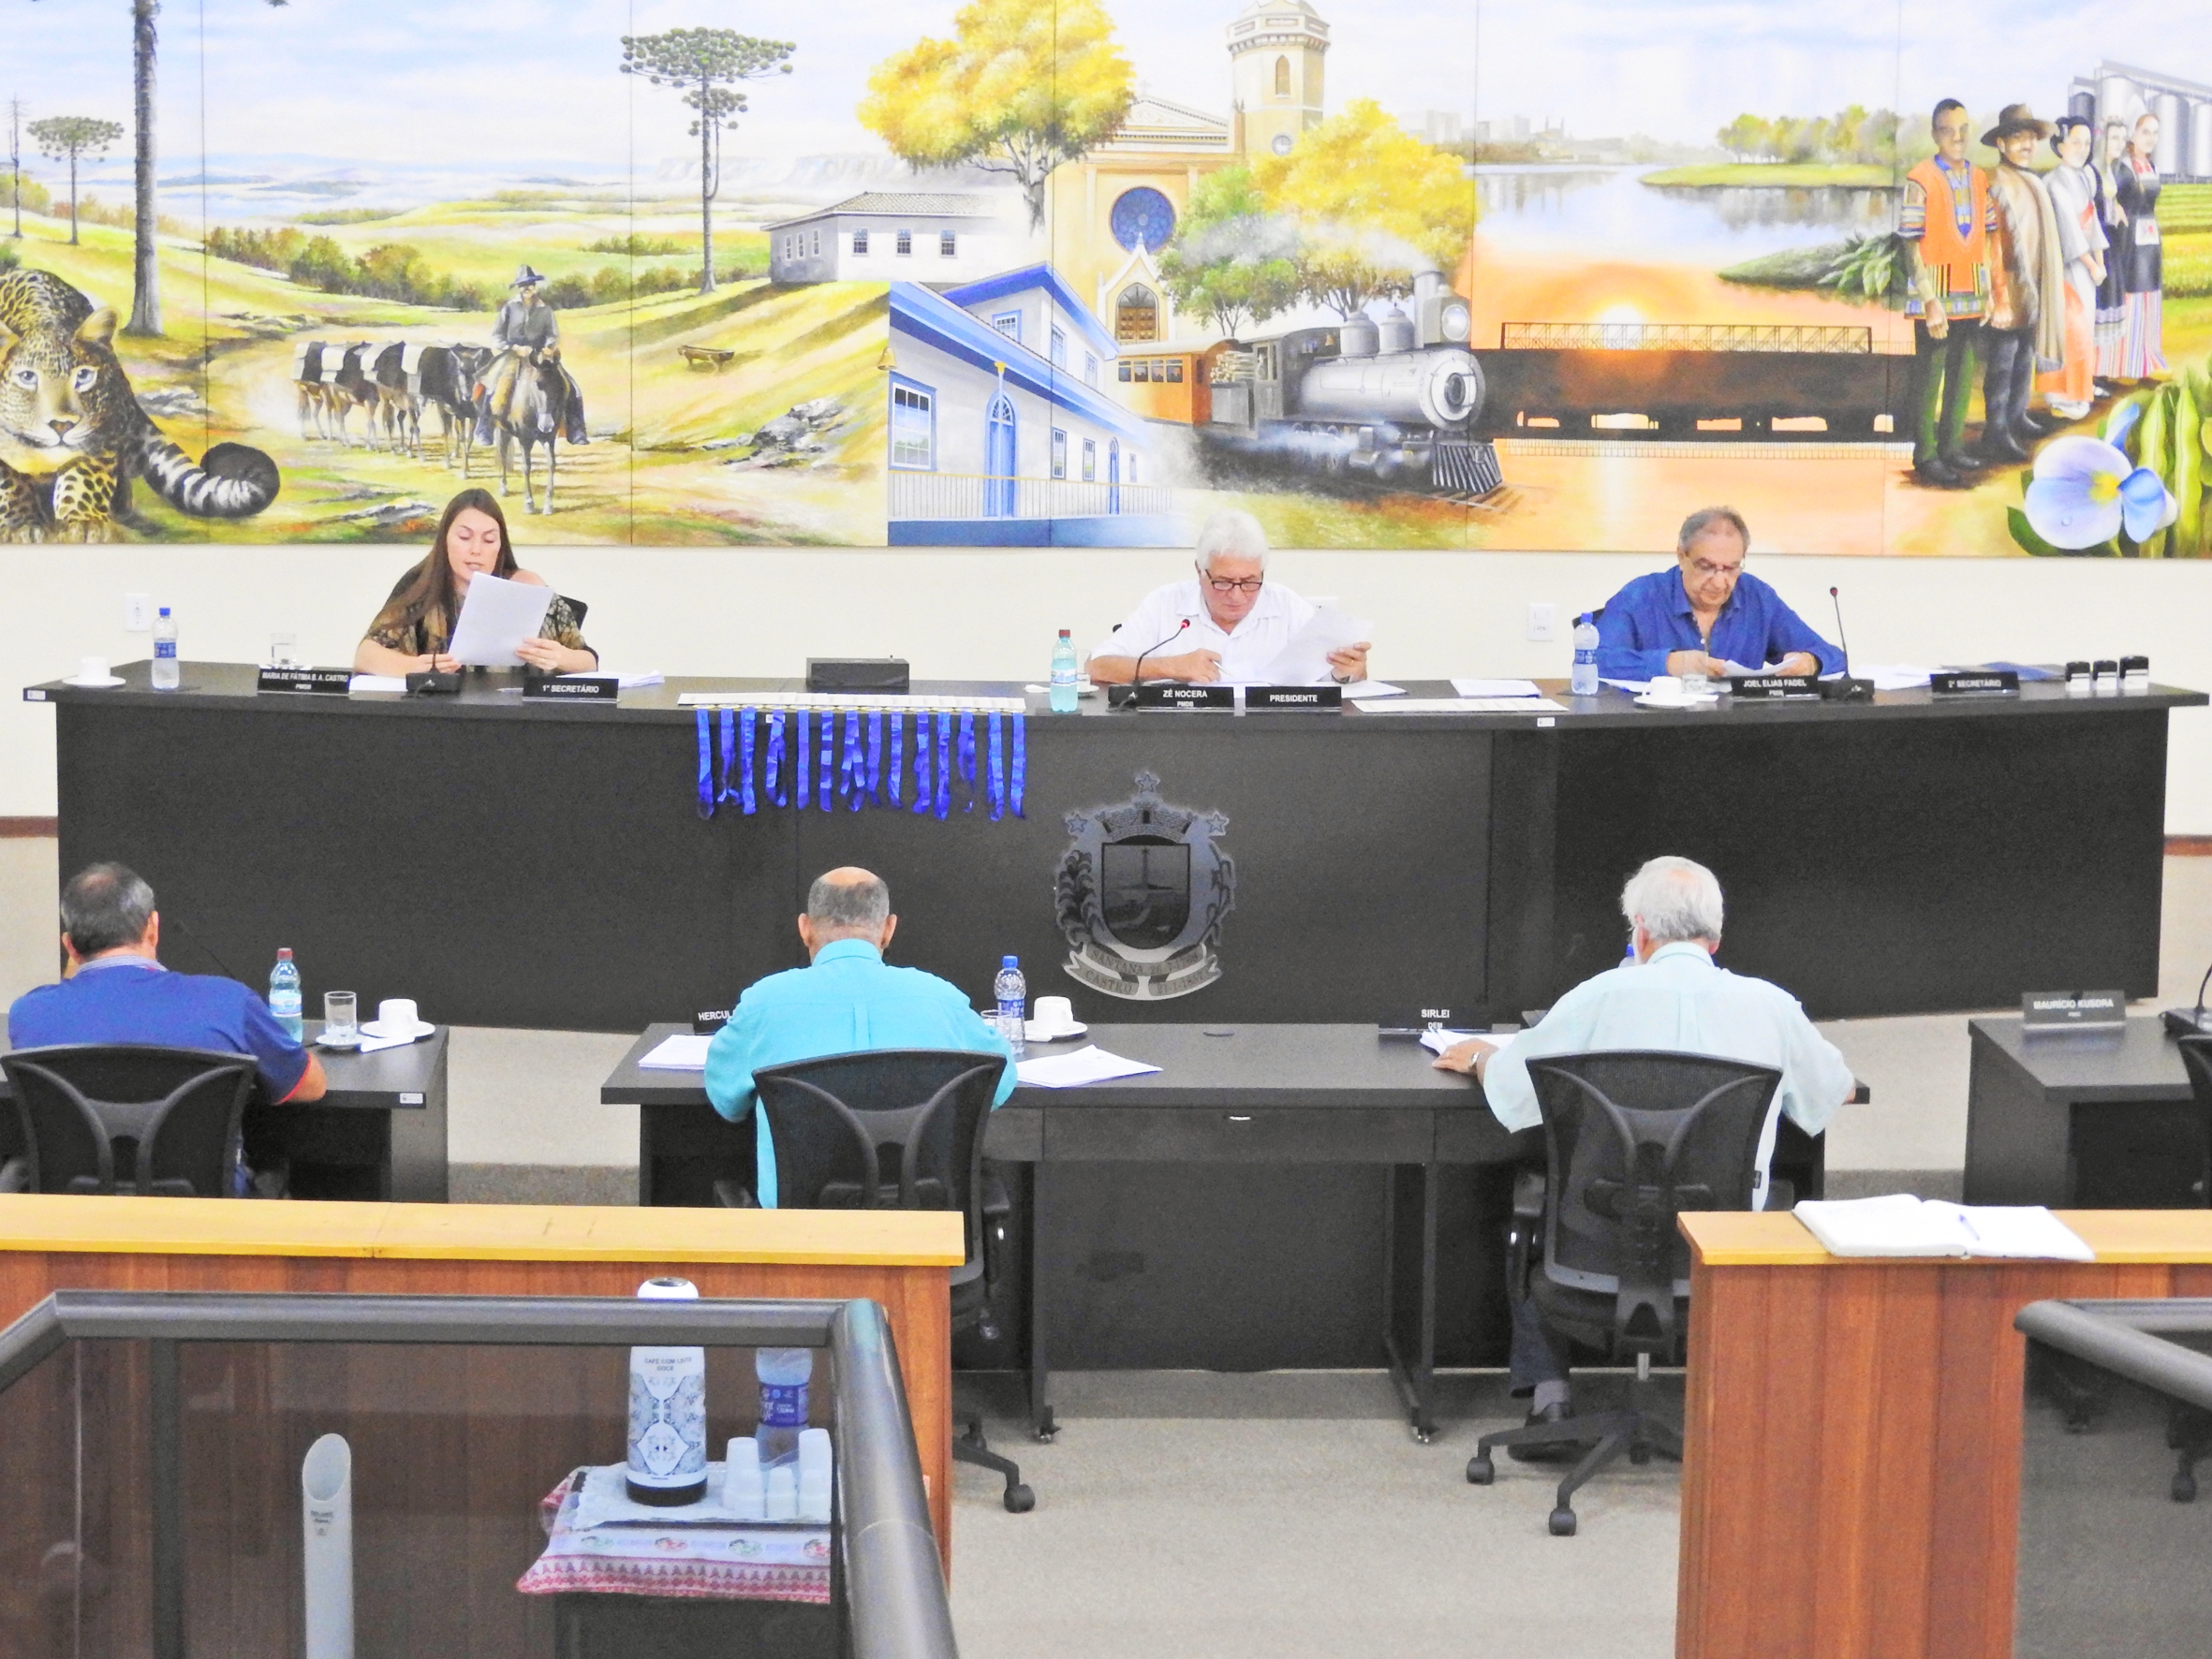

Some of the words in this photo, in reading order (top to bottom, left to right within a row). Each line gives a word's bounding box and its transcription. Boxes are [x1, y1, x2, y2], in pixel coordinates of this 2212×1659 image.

[262, 671, 281, 680] MARIA
[281, 672, 289, 681] DE
[290, 670, 311, 681] FÁTIMA
[324, 674, 349, 683] CASTRO
[1743, 680, 1762, 688] JOEL
[1762, 679, 1783, 688] ELIAS
[1783, 678, 1807, 687] FADEL
[1956, 678, 2002, 688] SECRETÁRIO
[551, 683, 600, 694] SECRETÁRIO
[1162, 688, 1173, 698] ZÉ
[1174, 689, 1208, 698] NOCERA
[1269, 694, 1319, 703] PRESIDENTE
[1085, 970, 1132, 994] CASTRO
[1421, 1008, 1451, 1019] SIRLEI
